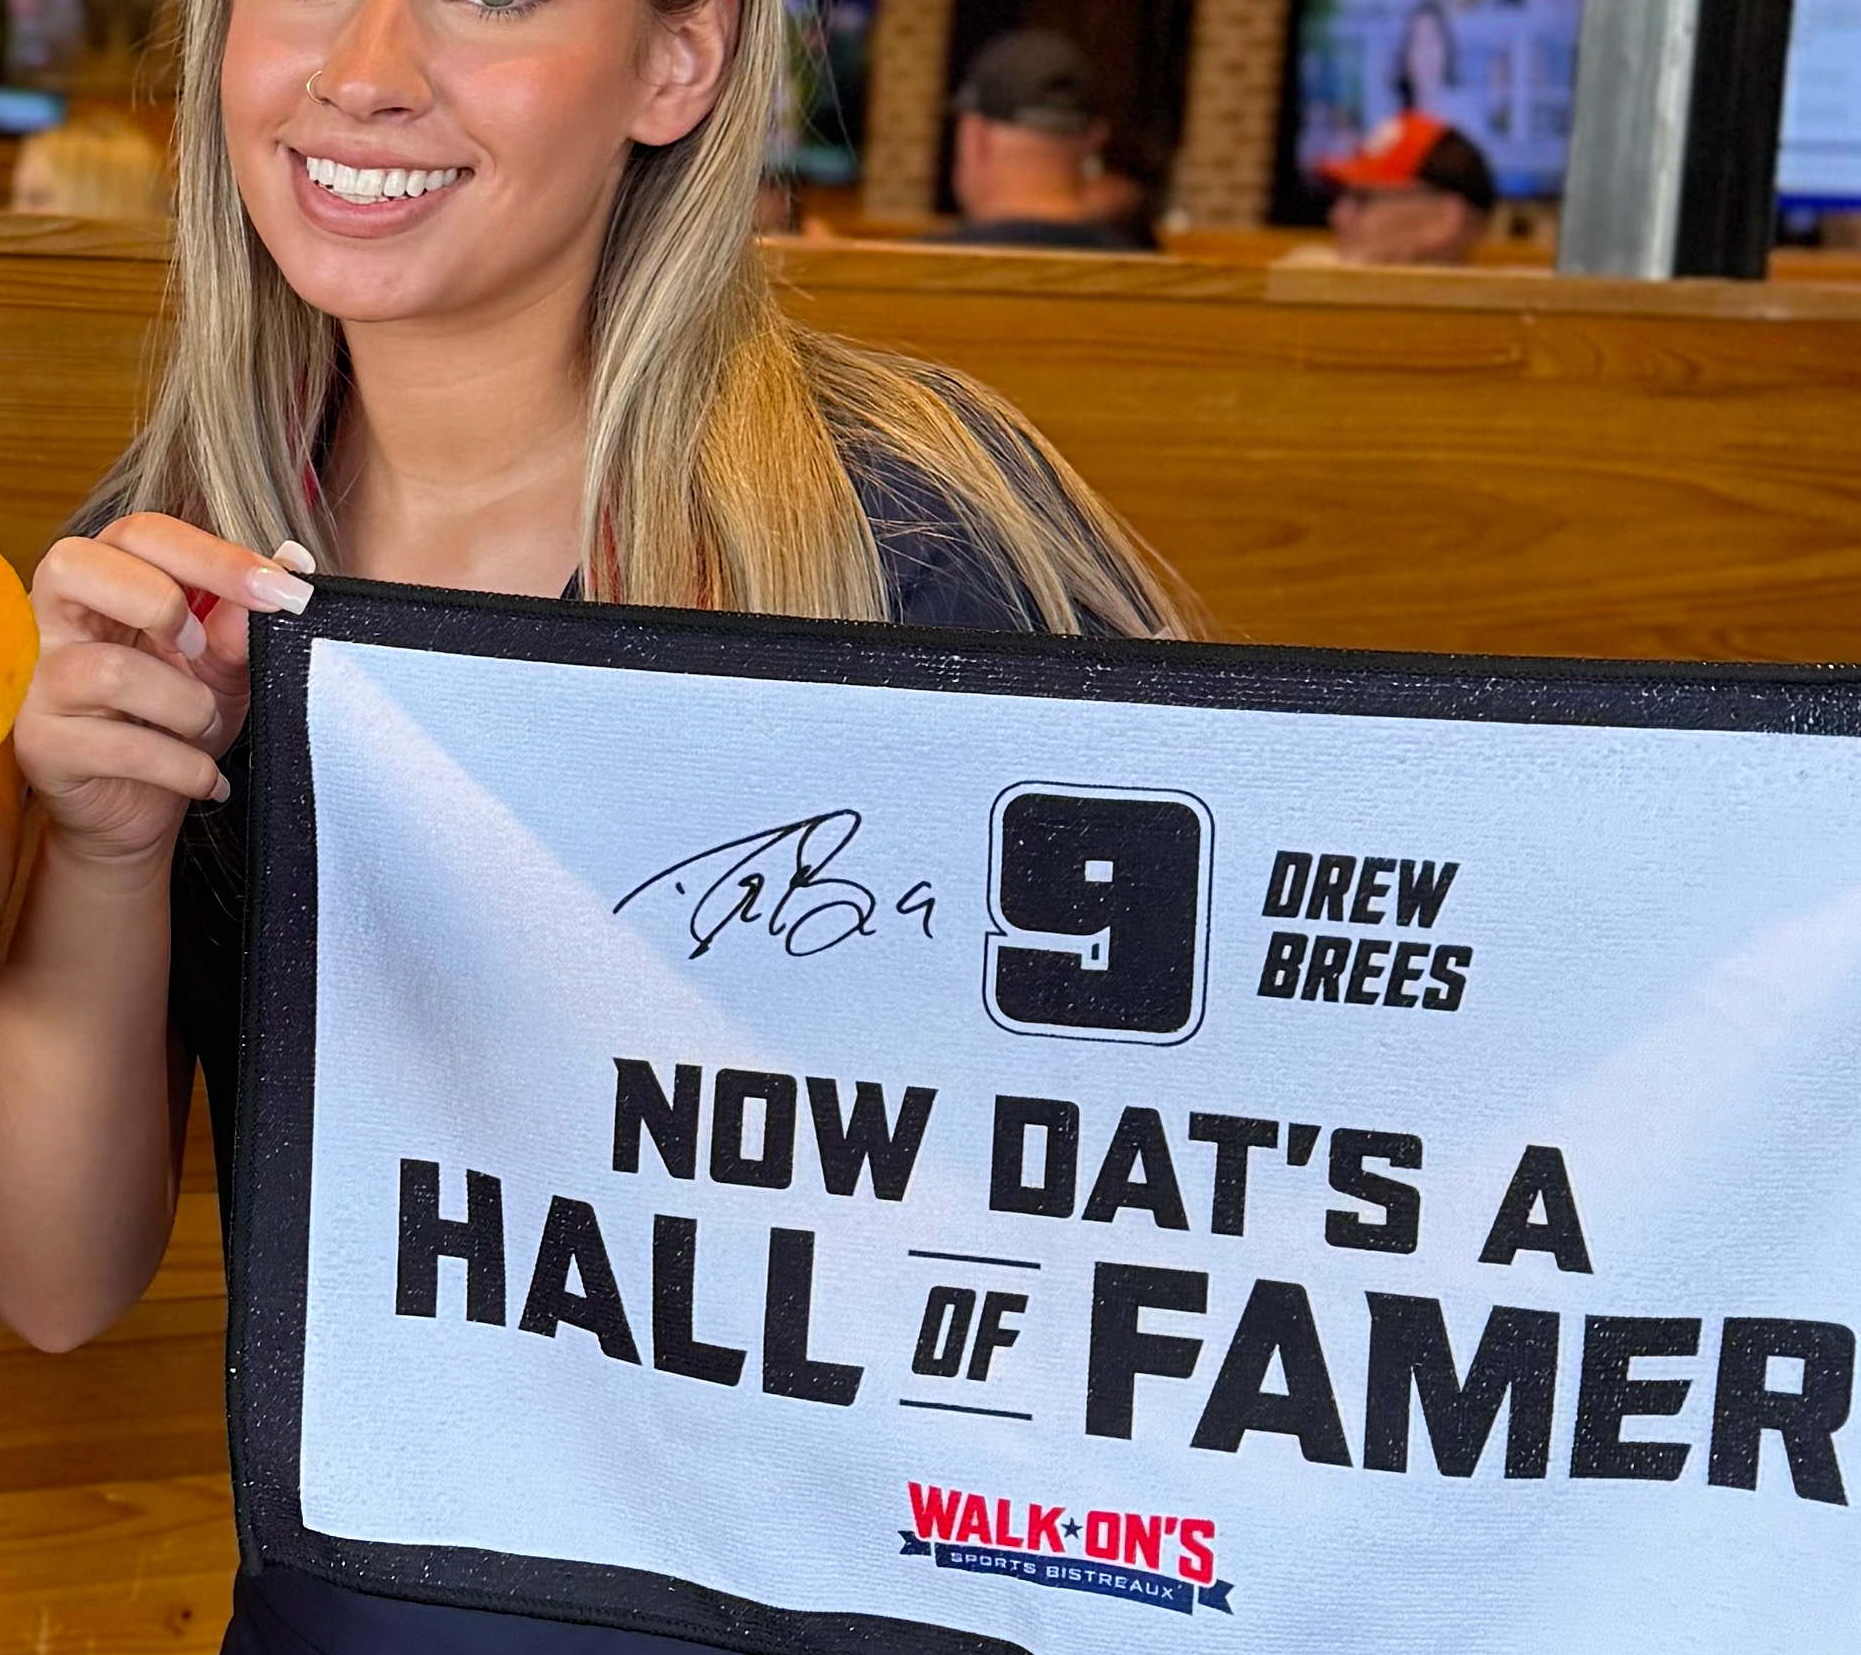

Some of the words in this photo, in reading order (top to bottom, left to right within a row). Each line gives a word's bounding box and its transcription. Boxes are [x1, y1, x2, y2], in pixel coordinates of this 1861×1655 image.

[982, 780, 1215, 1047] 9
[1261, 850, 1460, 929] DREW
[1256, 931, 1473, 1012] BREES
[612, 1057, 938, 1202] NOW
[989, 1094, 1423, 1255] DAT'S
[1478, 1144, 1594, 1275] A
[395, 1158, 864, 1407] HALL
[911, 1285, 1029, 1382] OF
[1085, 1261, 1856, 1506] FAMER
[906, 1480, 1067, 1554] WALK
[1084, 1510, 1216, 1585] ON'S
[950, 1552, 1037, 1575] SPORTS
[1046, 1565, 1175, 1601] BISTREAUX
